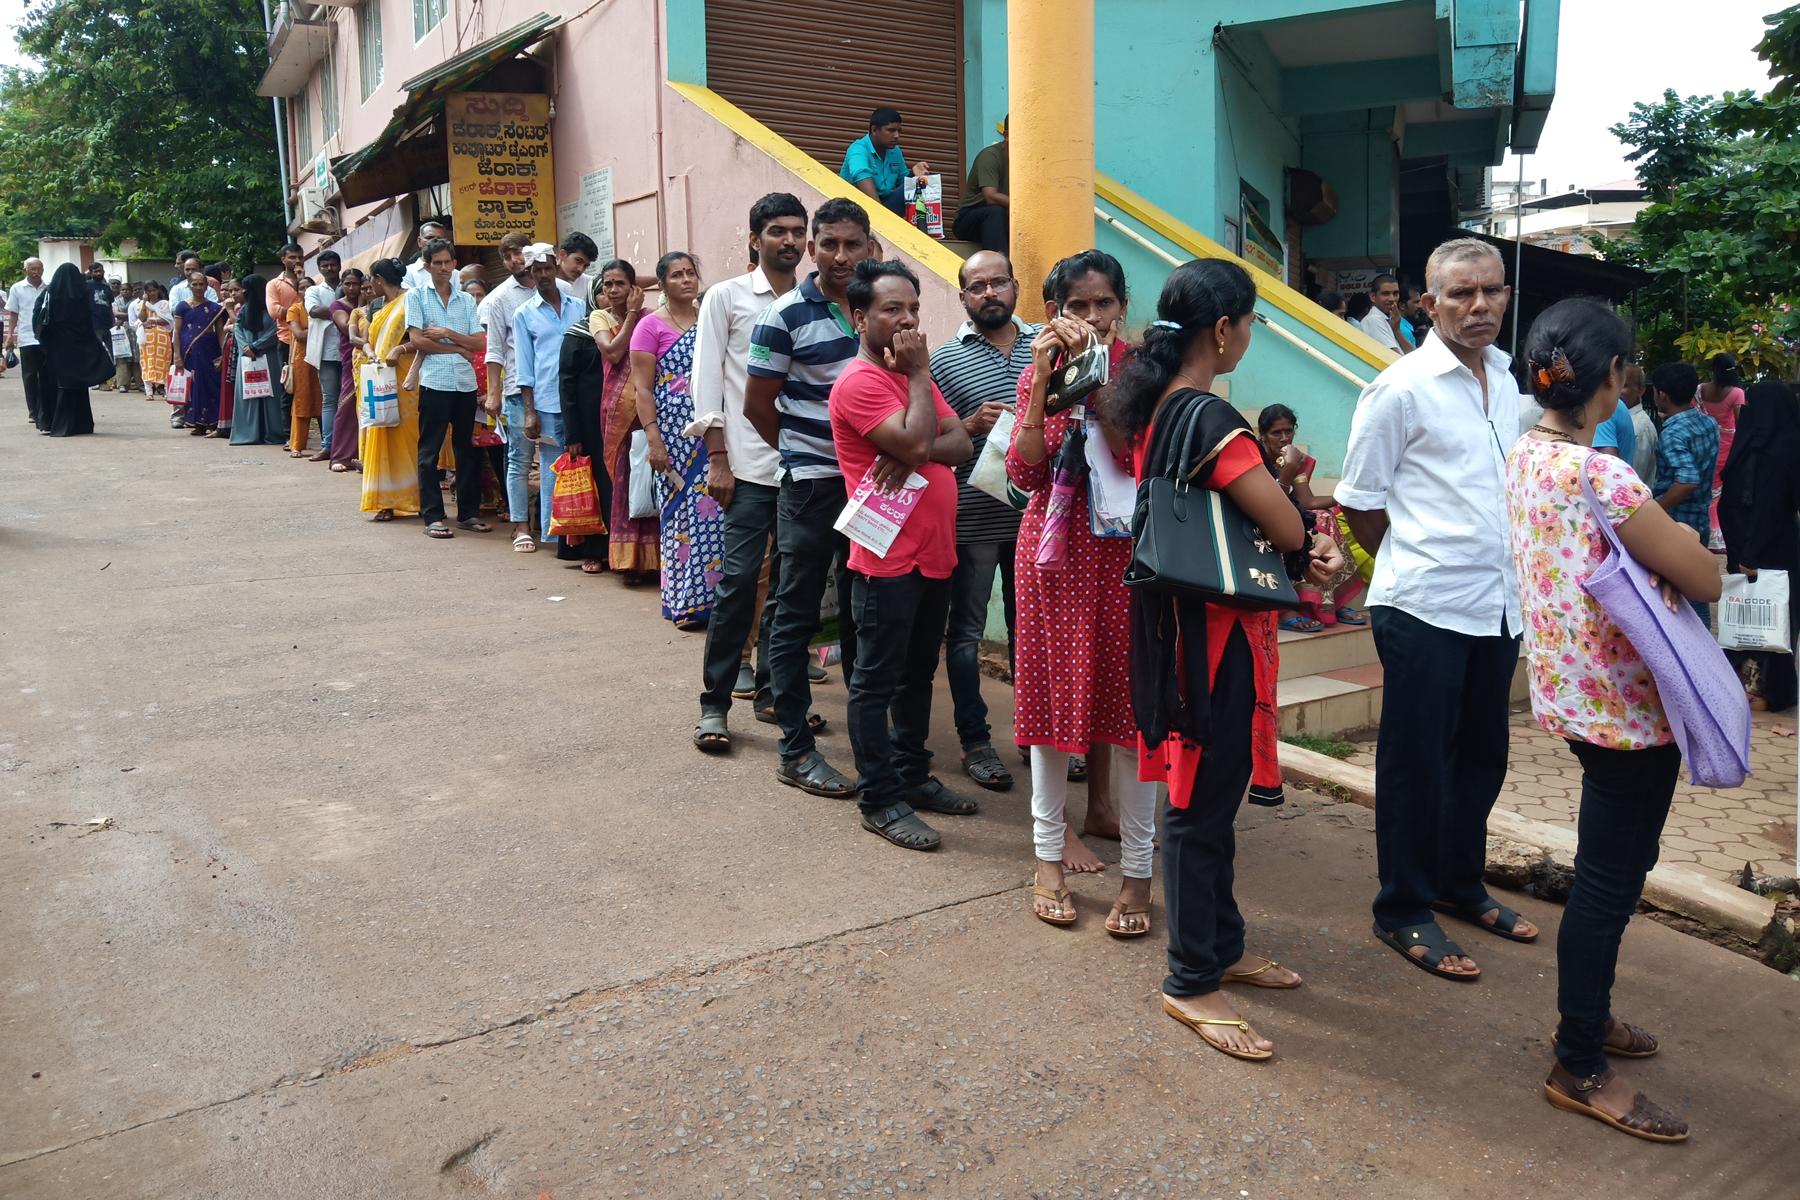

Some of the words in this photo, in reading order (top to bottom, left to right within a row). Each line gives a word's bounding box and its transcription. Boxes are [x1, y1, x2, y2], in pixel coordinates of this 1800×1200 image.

[504, 120, 549, 141] ಸೆಂಟರ್
[477, 157, 539, 177] ಜೆರಾಕ್ಸ್
[459, 182, 477, 195] ಕಲರ್
[478, 177, 539, 197] ಜೆರಾಕ್ಸ್
[1340, 282, 1362, 290] GOLD
[879, 502, 906, 525] ಕಲರ್ಸ್
